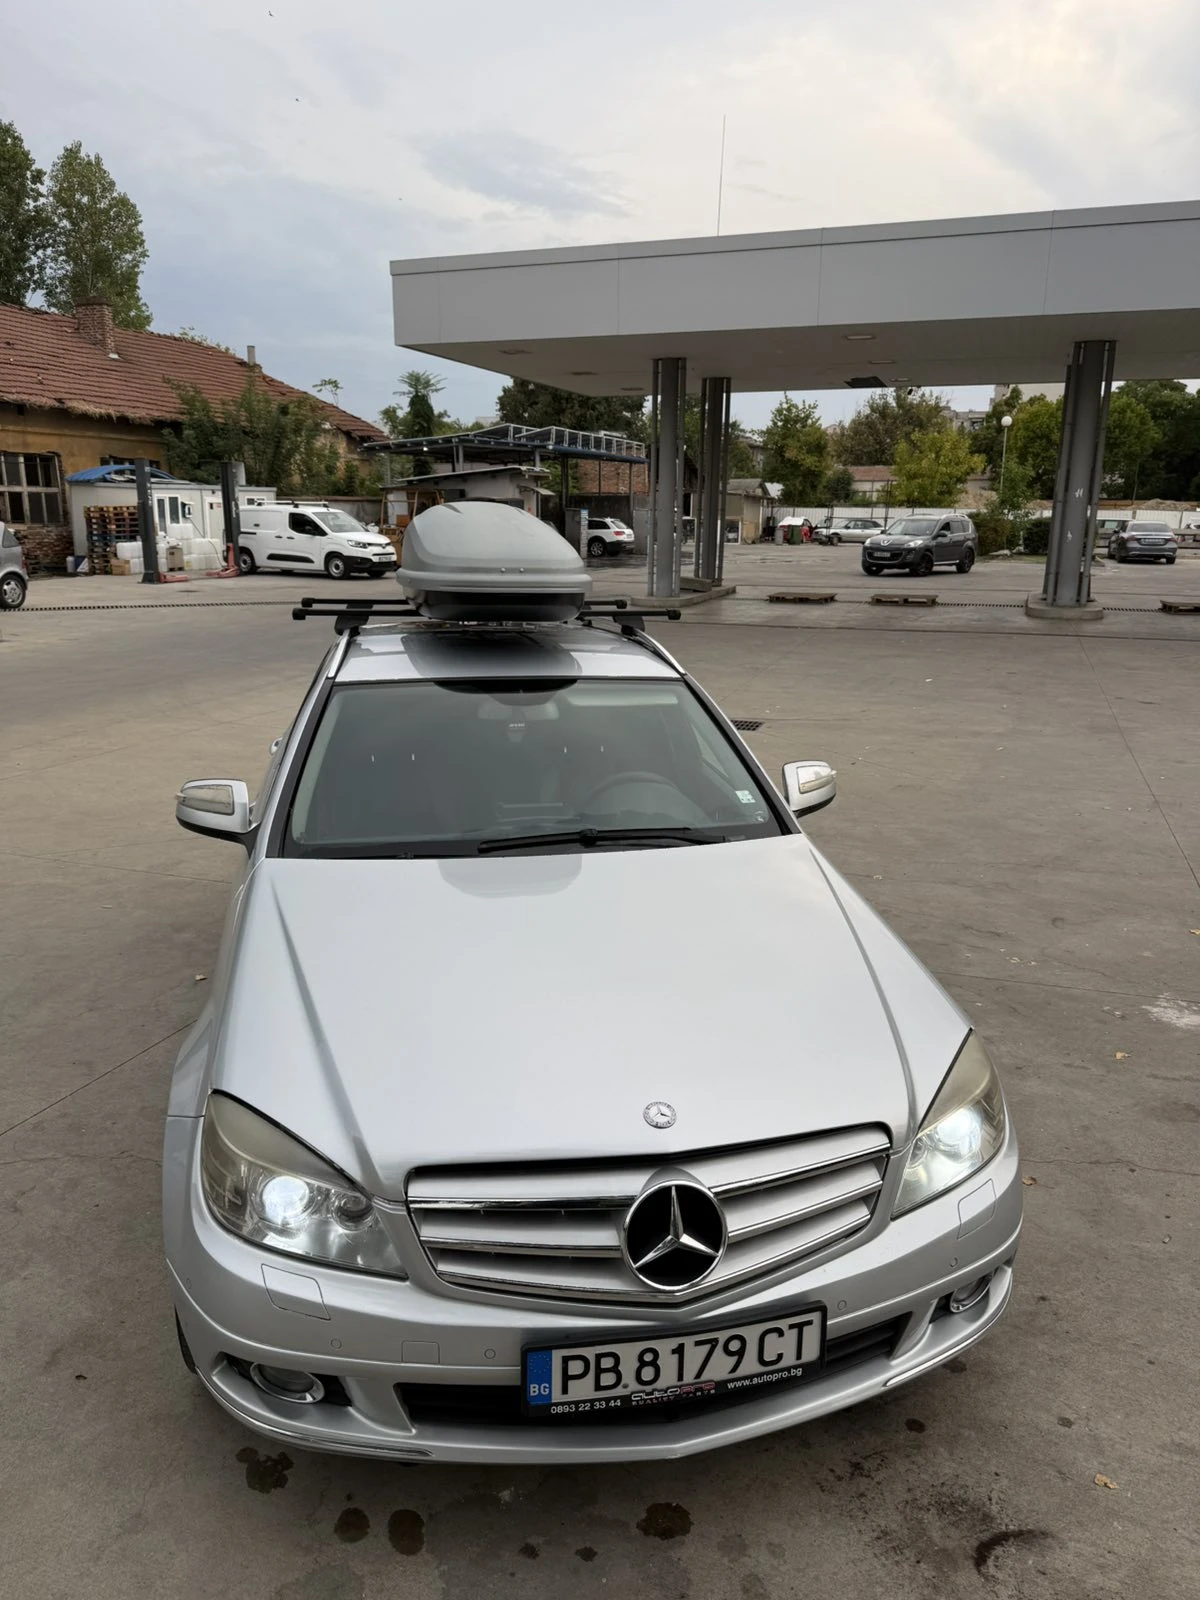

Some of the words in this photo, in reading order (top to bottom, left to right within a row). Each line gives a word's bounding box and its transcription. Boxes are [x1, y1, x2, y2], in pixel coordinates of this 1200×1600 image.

[727, 1366, 802, 1390] www.autopro.bg
[530, 1384, 549, 1396] BG
[551, 1404, 575, 1414] 0893
[578, 1403, 591, 1411] 22
[593, 1401, 606, 1410] 33
[608, 1399, 621, 1408] 44
